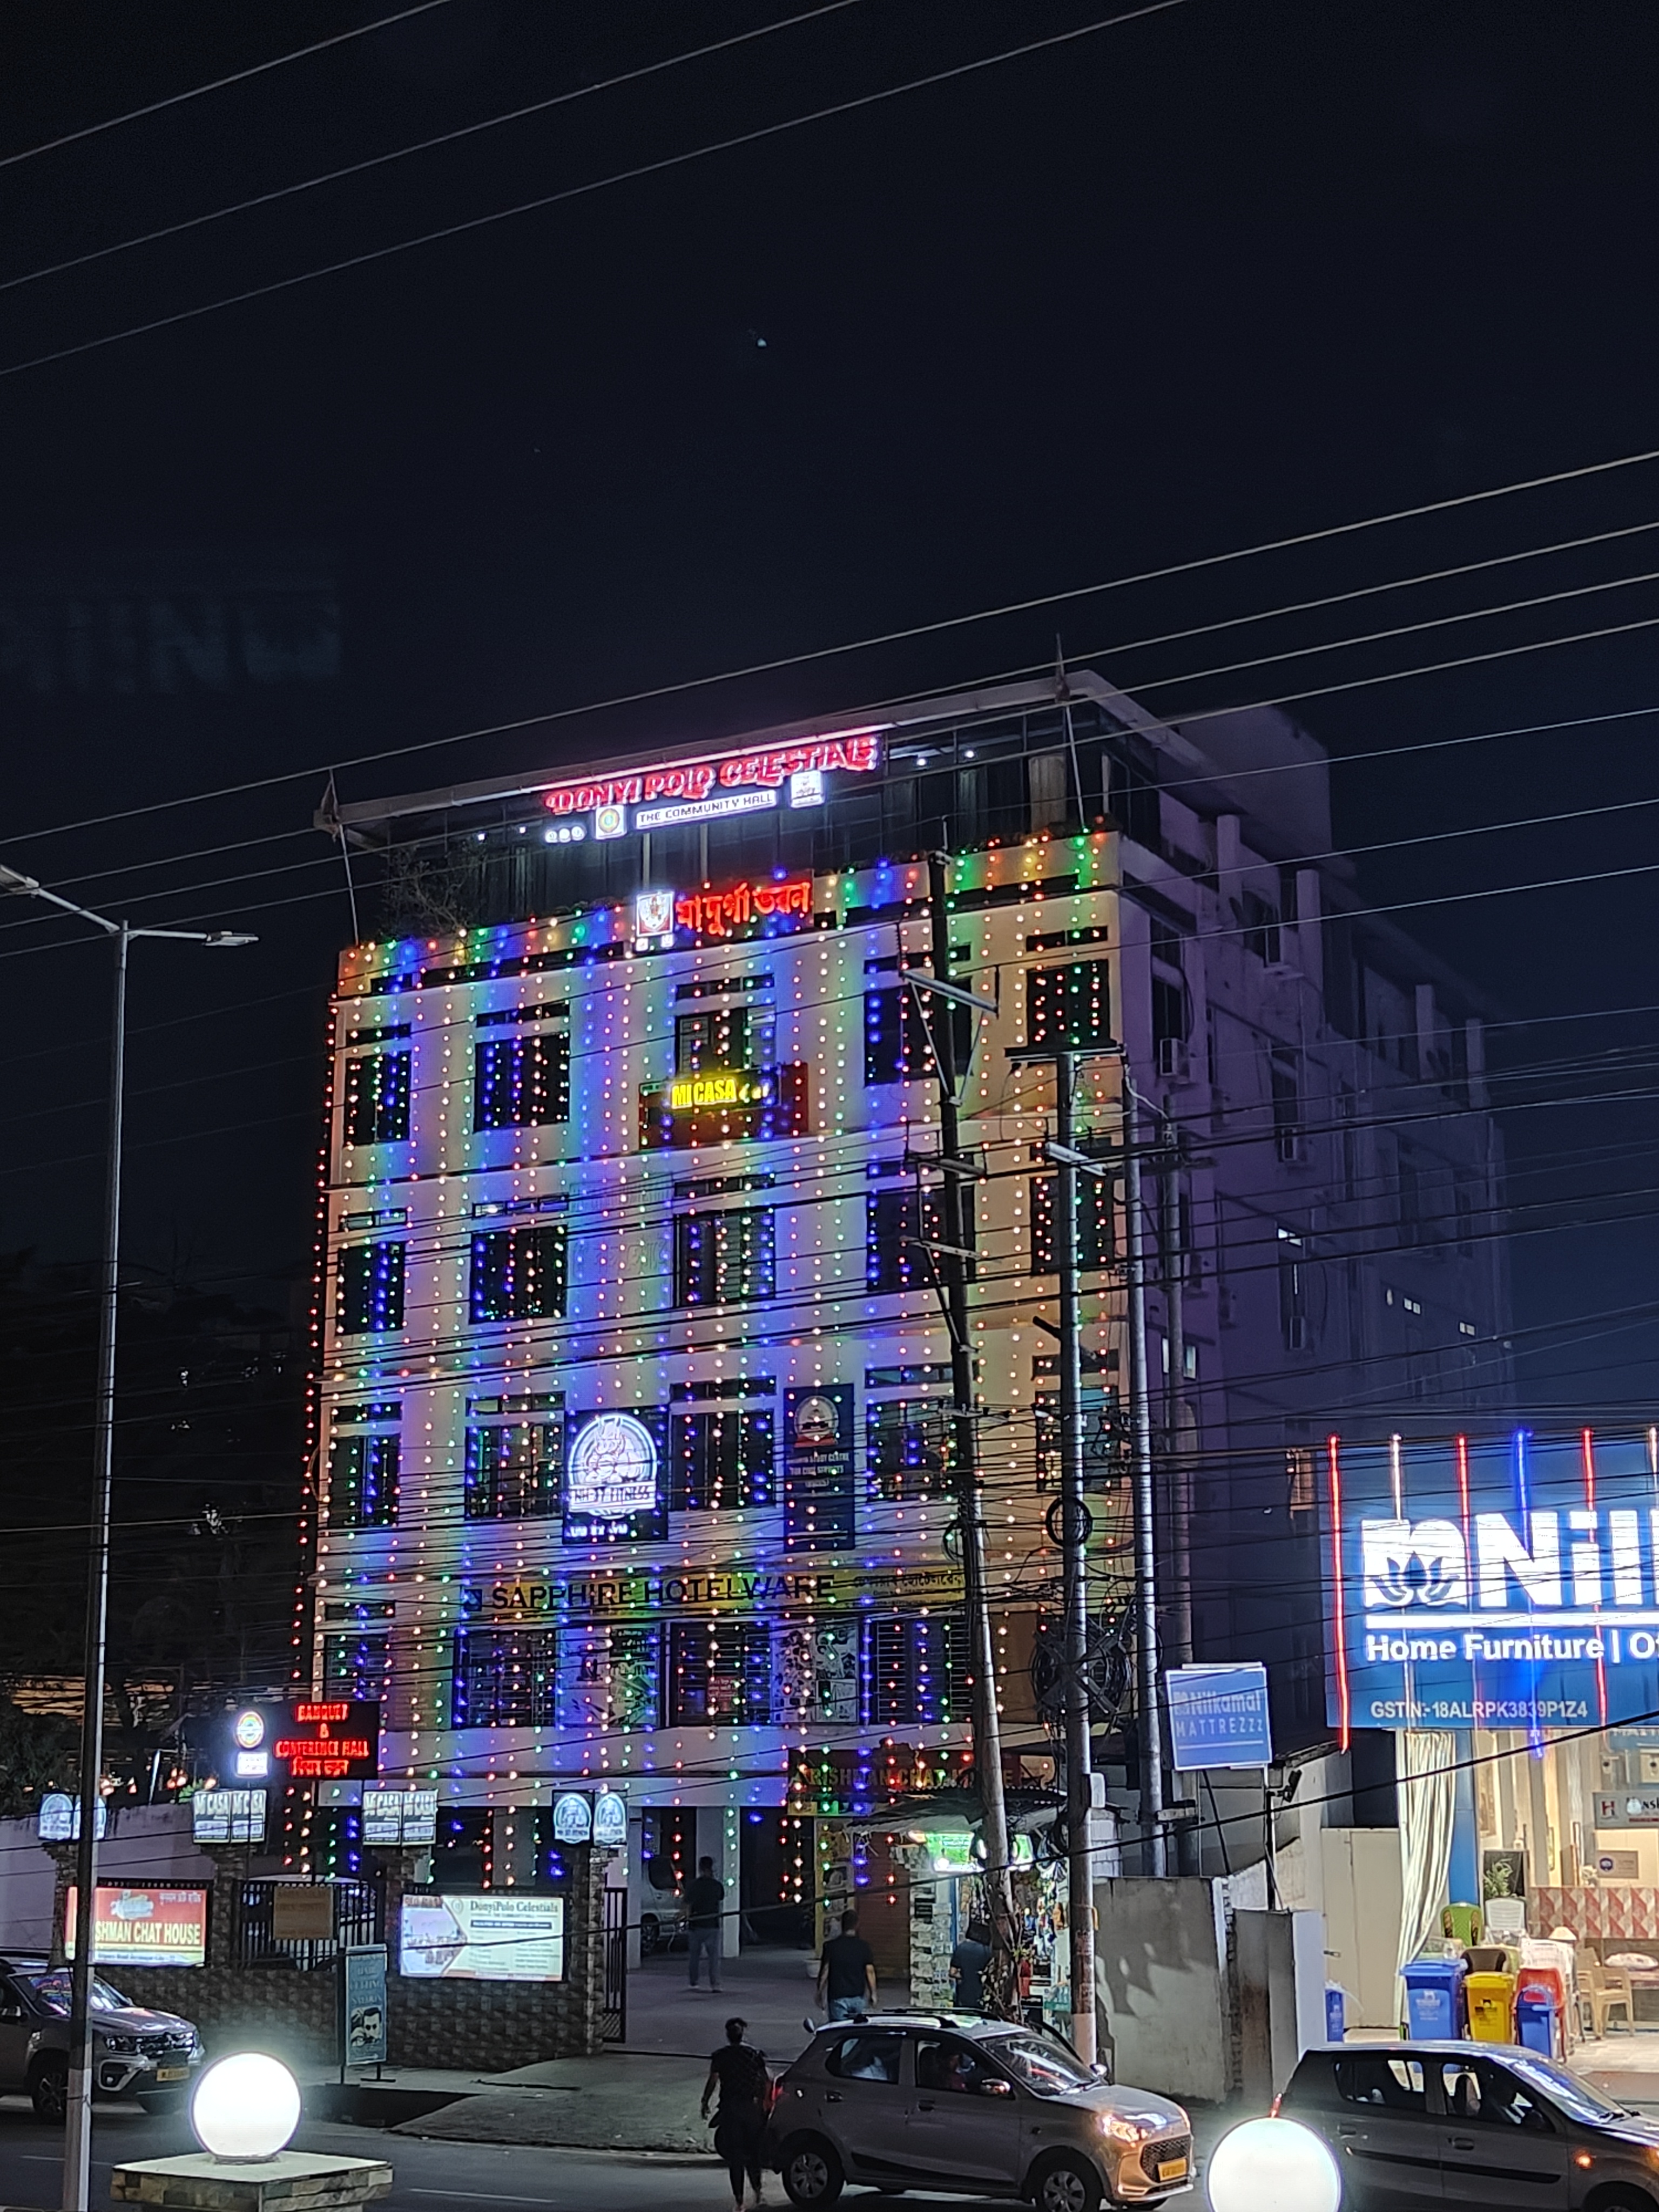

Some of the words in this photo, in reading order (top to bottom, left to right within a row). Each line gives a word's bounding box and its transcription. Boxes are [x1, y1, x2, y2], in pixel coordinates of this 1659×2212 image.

[544, 777, 642, 815] DONYI
[644, 764, 717, 800] POLO
[639, 812, 661, 823] THE
[665, 800, 739, 819] COMMUNITY
[743, 793, 773, 806] HALL
[693, 1078, 737, 1105] CASA
[1476, 1510, 1659, 1608] Nil
[492, 1581, 632, 1609] SAPPHIRE
[644, 1574, 834, 1603] HOTELWARE
[1366, 1634, 1456, 1662] Home
[1463, 1631, 1604, 1661] Furniture
[1629, 1631, 1659, 1660] O
[1175, 1717, 1263, 1737] MATTREZZZ
[342, 1740, 369, 1757] HALL
[207, 1793, 228, 1815] CASA
[244, 1792, 264, 1814] CSA
[95, 1920, 132, 1943] SHMAN
[134, 1921, 161, 1944] CHAT
[164, 1923, 200, 1945] HOUSE
